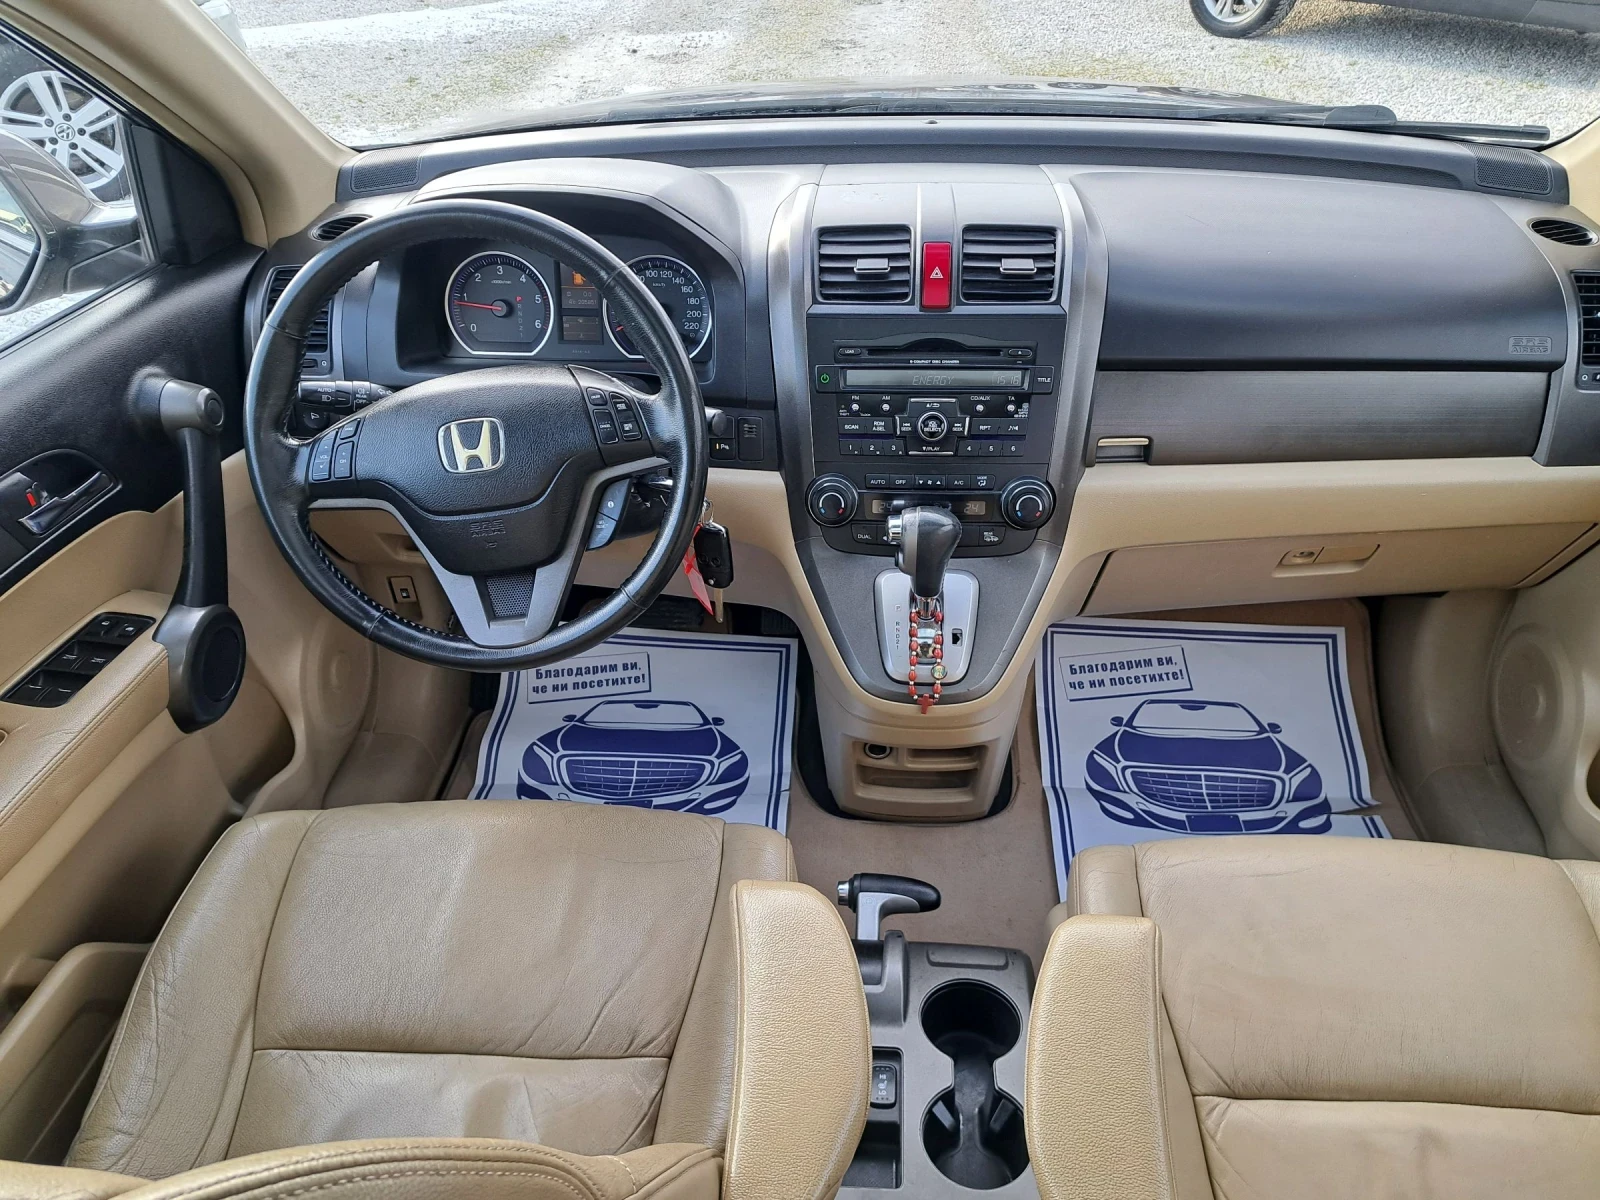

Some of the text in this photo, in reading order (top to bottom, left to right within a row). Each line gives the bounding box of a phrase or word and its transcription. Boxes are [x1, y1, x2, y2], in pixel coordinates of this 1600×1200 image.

[496, 265, 503, 275] 3
[645, 270, 658, 278] 100
[660, 270, 673, 278] 120
[474, 273, 482, 282] 2
[519, 274, 526, 283] 4
[681, 285, 693, 293] 160
[463, 292, 468, 301] 1
[534, 294, 542, 303] 5
[687, 297, 700, 305] 180
[686, 310, 702, 318] 200
[470, 323, 477, 332] 0
[534, 319, 542, 329] 6
[684, 322, 700, 330] 220
[912, 375, 955, 386] ENERGY
[963, 503, 979, 514] 24
[1069, 656, 1178, 676] Благодарим ви,
[535, 663, 618, 680] Благодарим
[532, 673, 646, 694] че ни посетихте!
[1069, 669, 1185, 690] че ни посетихте!
